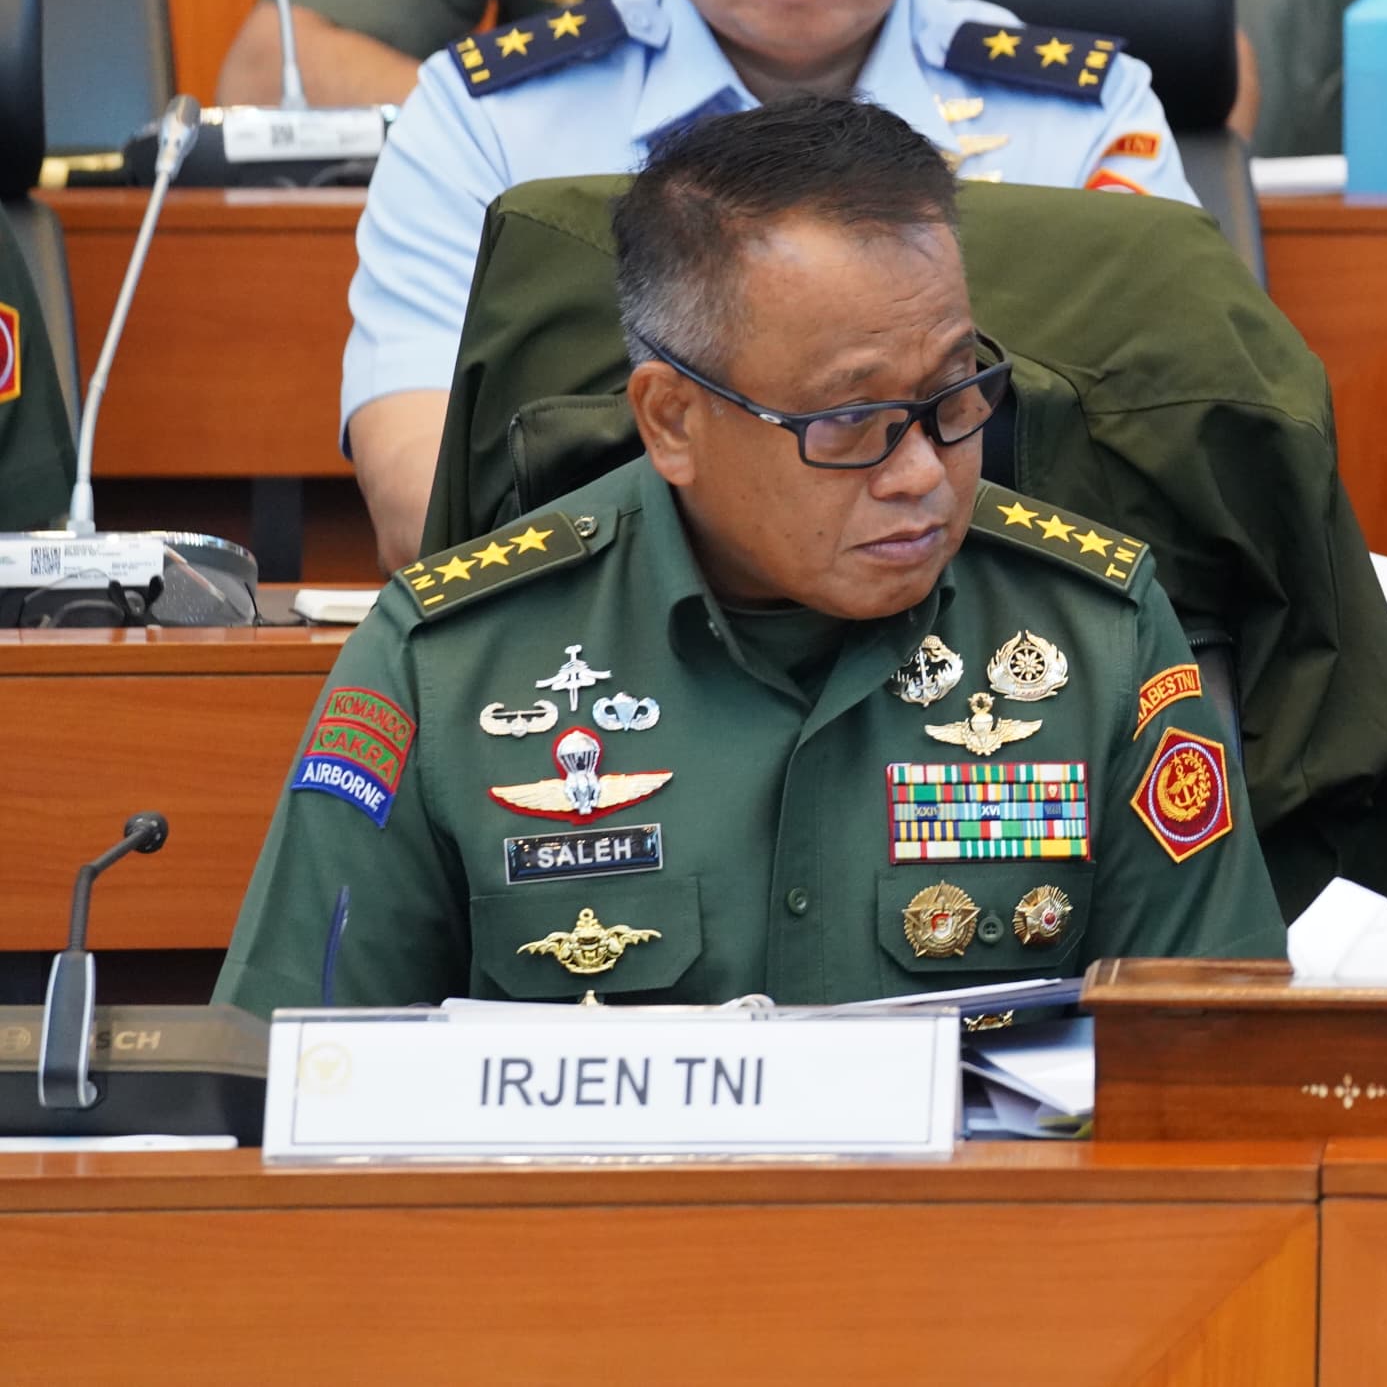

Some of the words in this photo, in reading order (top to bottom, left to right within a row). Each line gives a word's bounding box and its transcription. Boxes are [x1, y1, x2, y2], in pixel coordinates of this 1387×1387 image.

[456, 37, 491, 84] TNI
[1078, 39, 1115, 87] TNI
[1105, 537, 1143, 579] TNI
[403, 561, 445, 606] TNI
[333, 694, 407, 742] KOMANDO
[1138, 676, 1177, 723] ABES
[318, 728, 395, 781] CAKRA
[301, 760, 387, 813] AIRBORNE
[537, 836, 632, 869] SALEH
[479, 1056, 650, 1107] IRJEN
[673, 1056, 765, 1106] TNI
